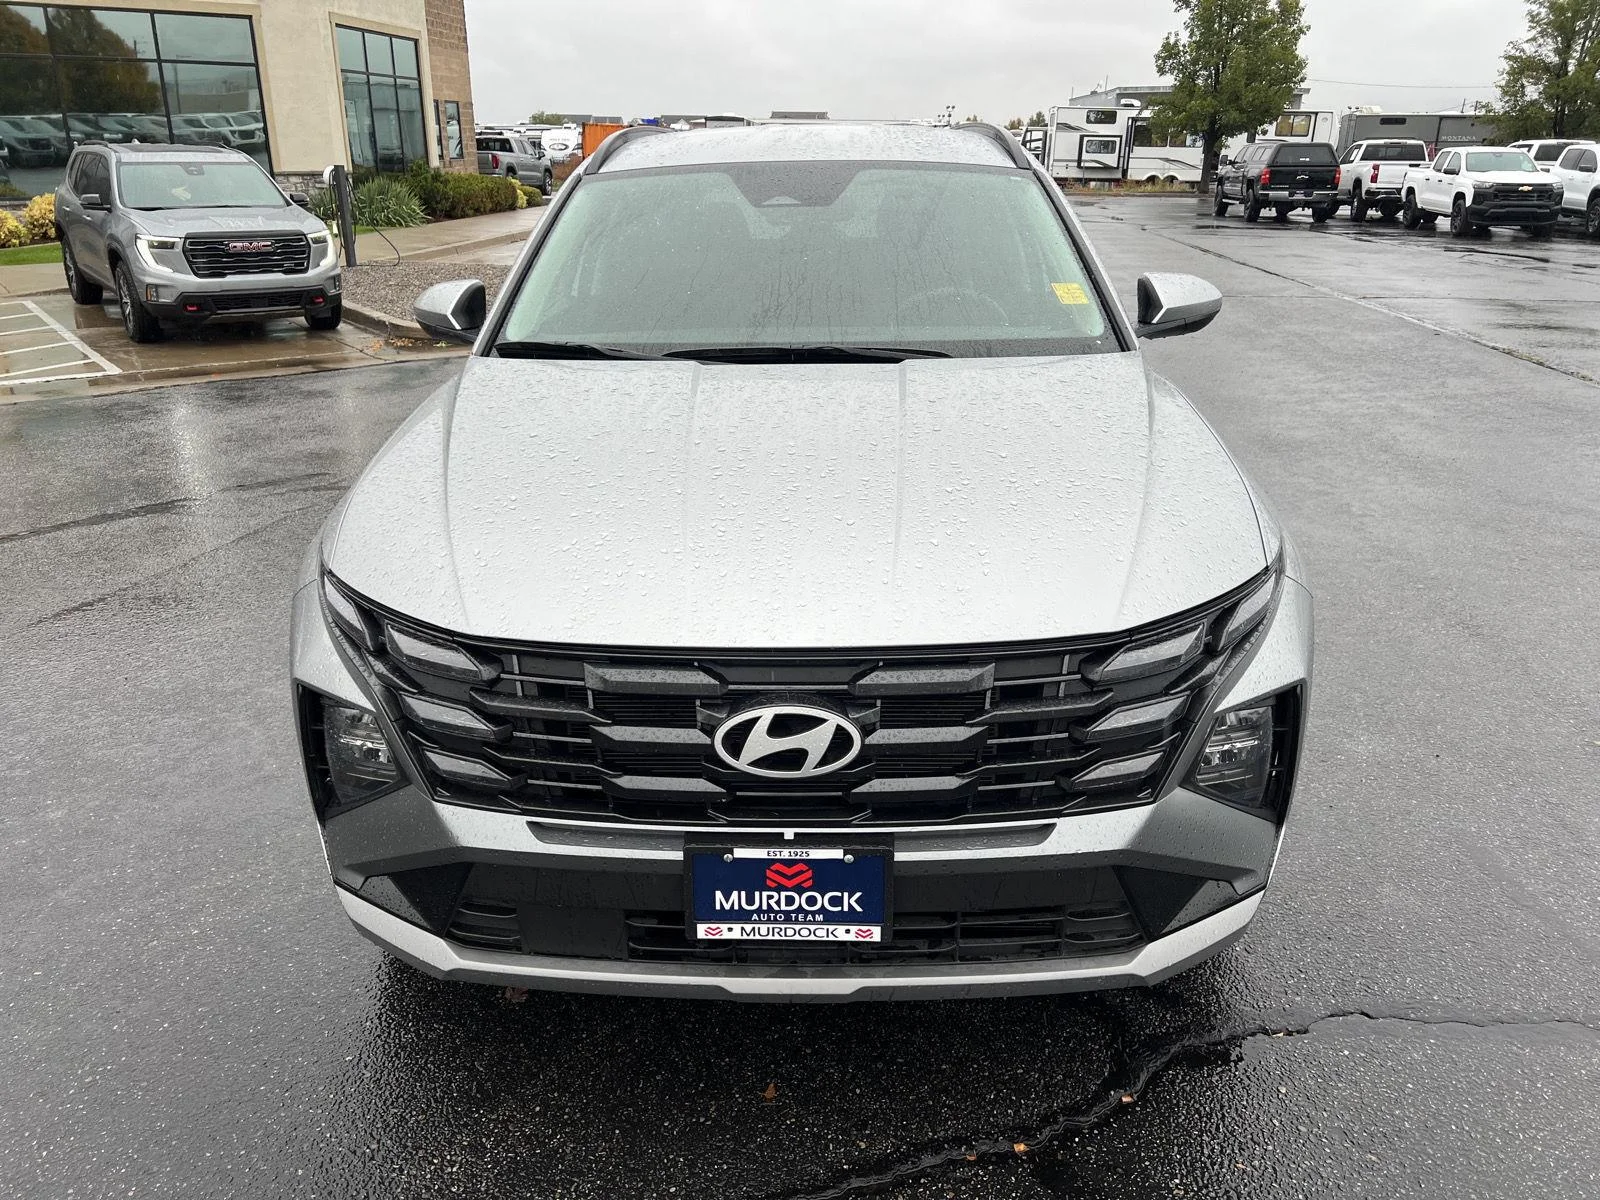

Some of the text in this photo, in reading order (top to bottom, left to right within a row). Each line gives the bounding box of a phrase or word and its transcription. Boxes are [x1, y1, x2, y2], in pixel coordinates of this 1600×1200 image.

[228, 241, 273, 253] GMC
[766, 850, 810, 858] EST. 1925
[714, 890, 864, 912] MURDOCK
[751, 913, 824, 922] AUTO TEAM
[740, 926, 839, 939] MURDOCK
